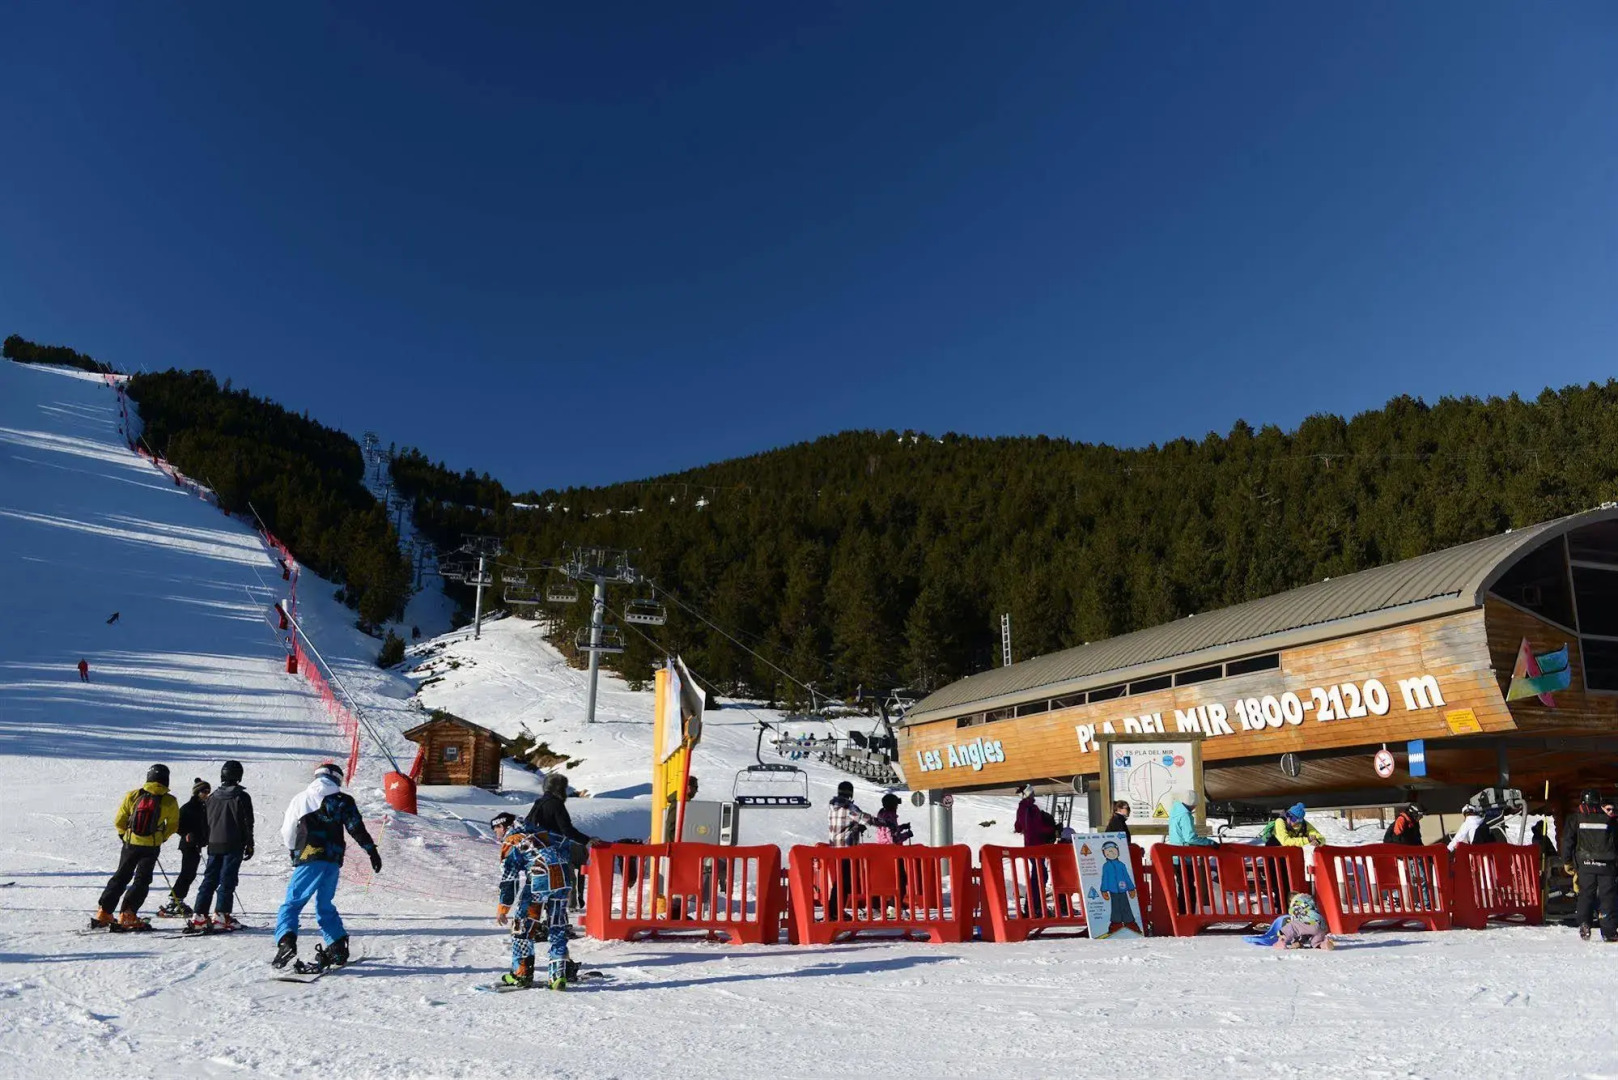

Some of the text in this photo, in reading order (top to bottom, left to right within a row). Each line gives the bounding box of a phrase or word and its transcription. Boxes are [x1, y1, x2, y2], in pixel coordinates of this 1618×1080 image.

[1174, 703, 1235, 738] MIR
[1234, 678, 1390, 731] 1800-2120
[1397, 674, 1447, 711] m
[916, 737, 1005, 772] Les Angles
